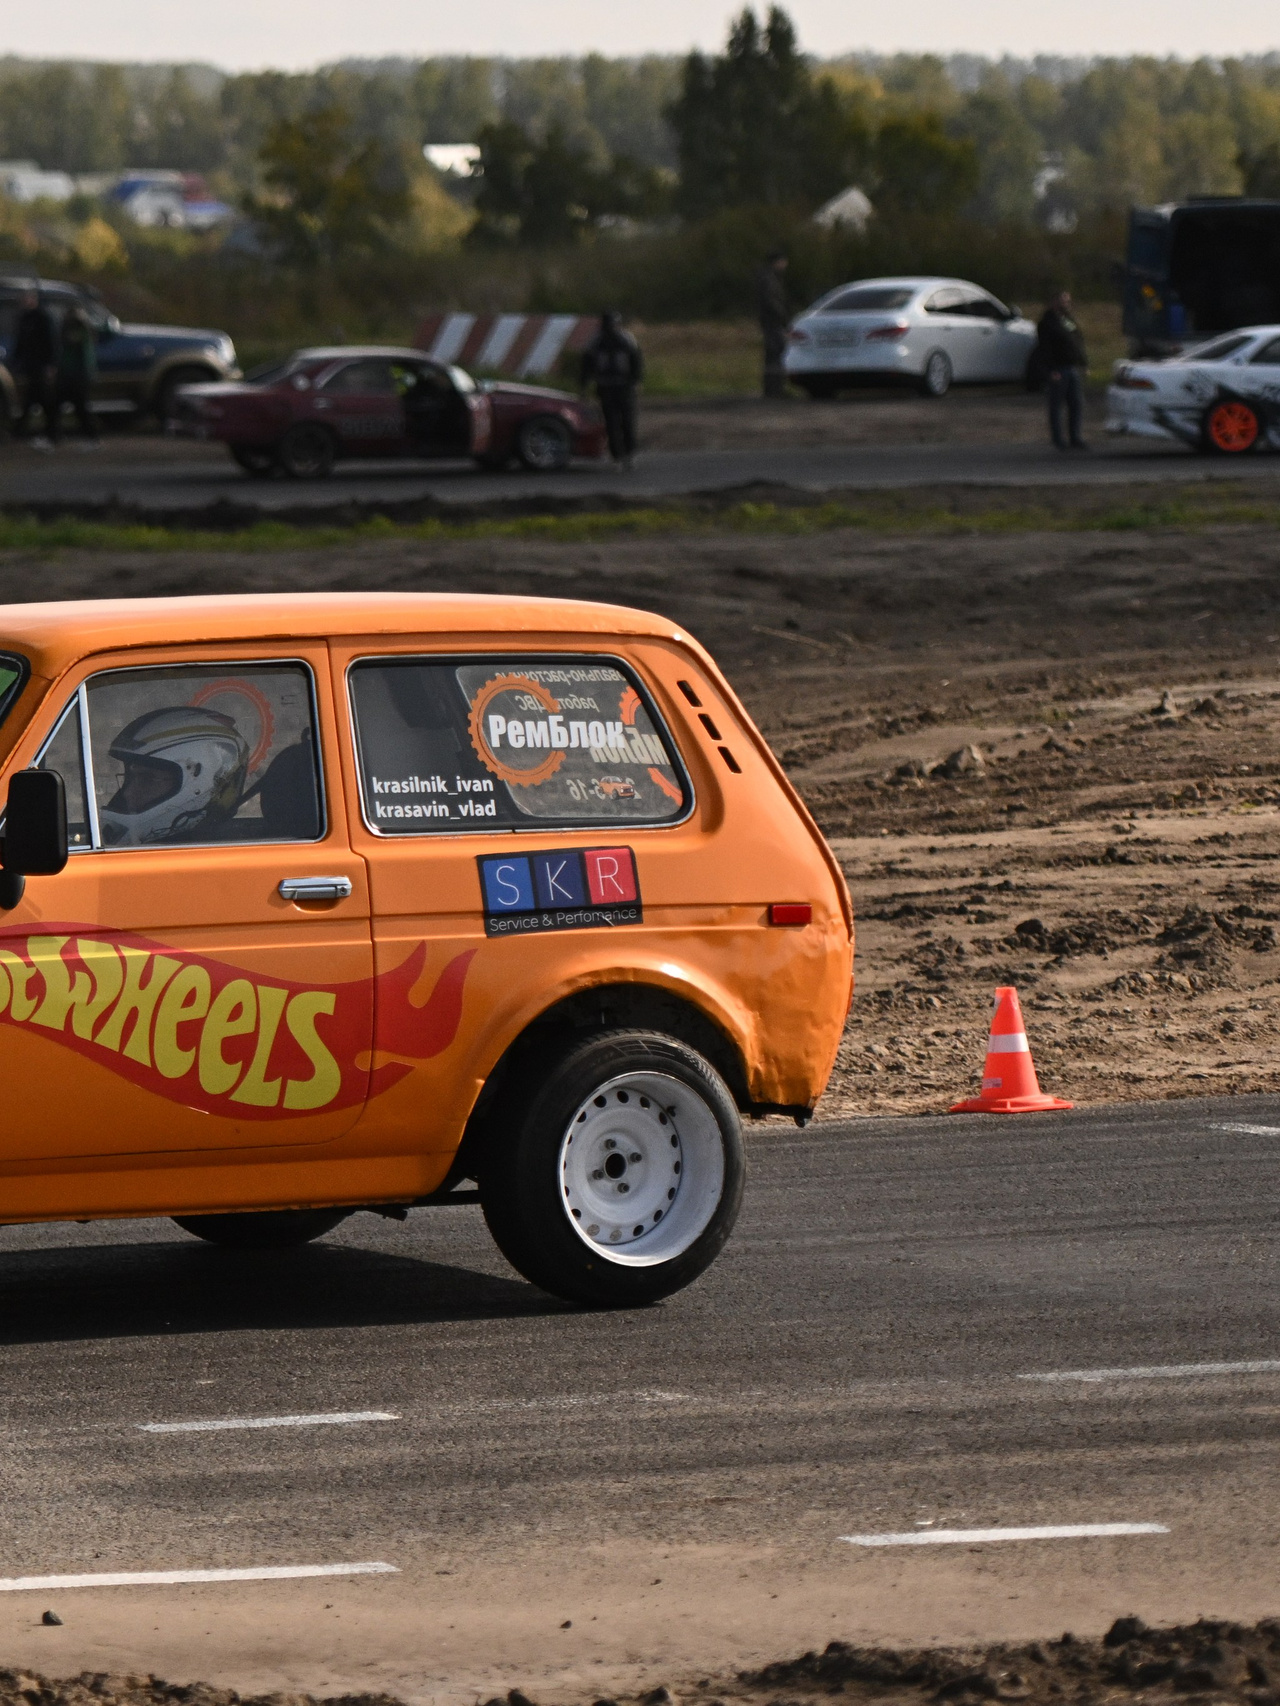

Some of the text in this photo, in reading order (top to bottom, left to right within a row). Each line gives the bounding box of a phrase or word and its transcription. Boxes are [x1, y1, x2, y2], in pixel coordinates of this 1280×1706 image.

[488, 714, 626, 748] РемБлок
[372, 775, 494, 795] krasilnik_ivan
[375, 799, 497, 820] krasavin_vlad
[490, 916, 539, 932] Service
[542, 913, 553, 927] &
